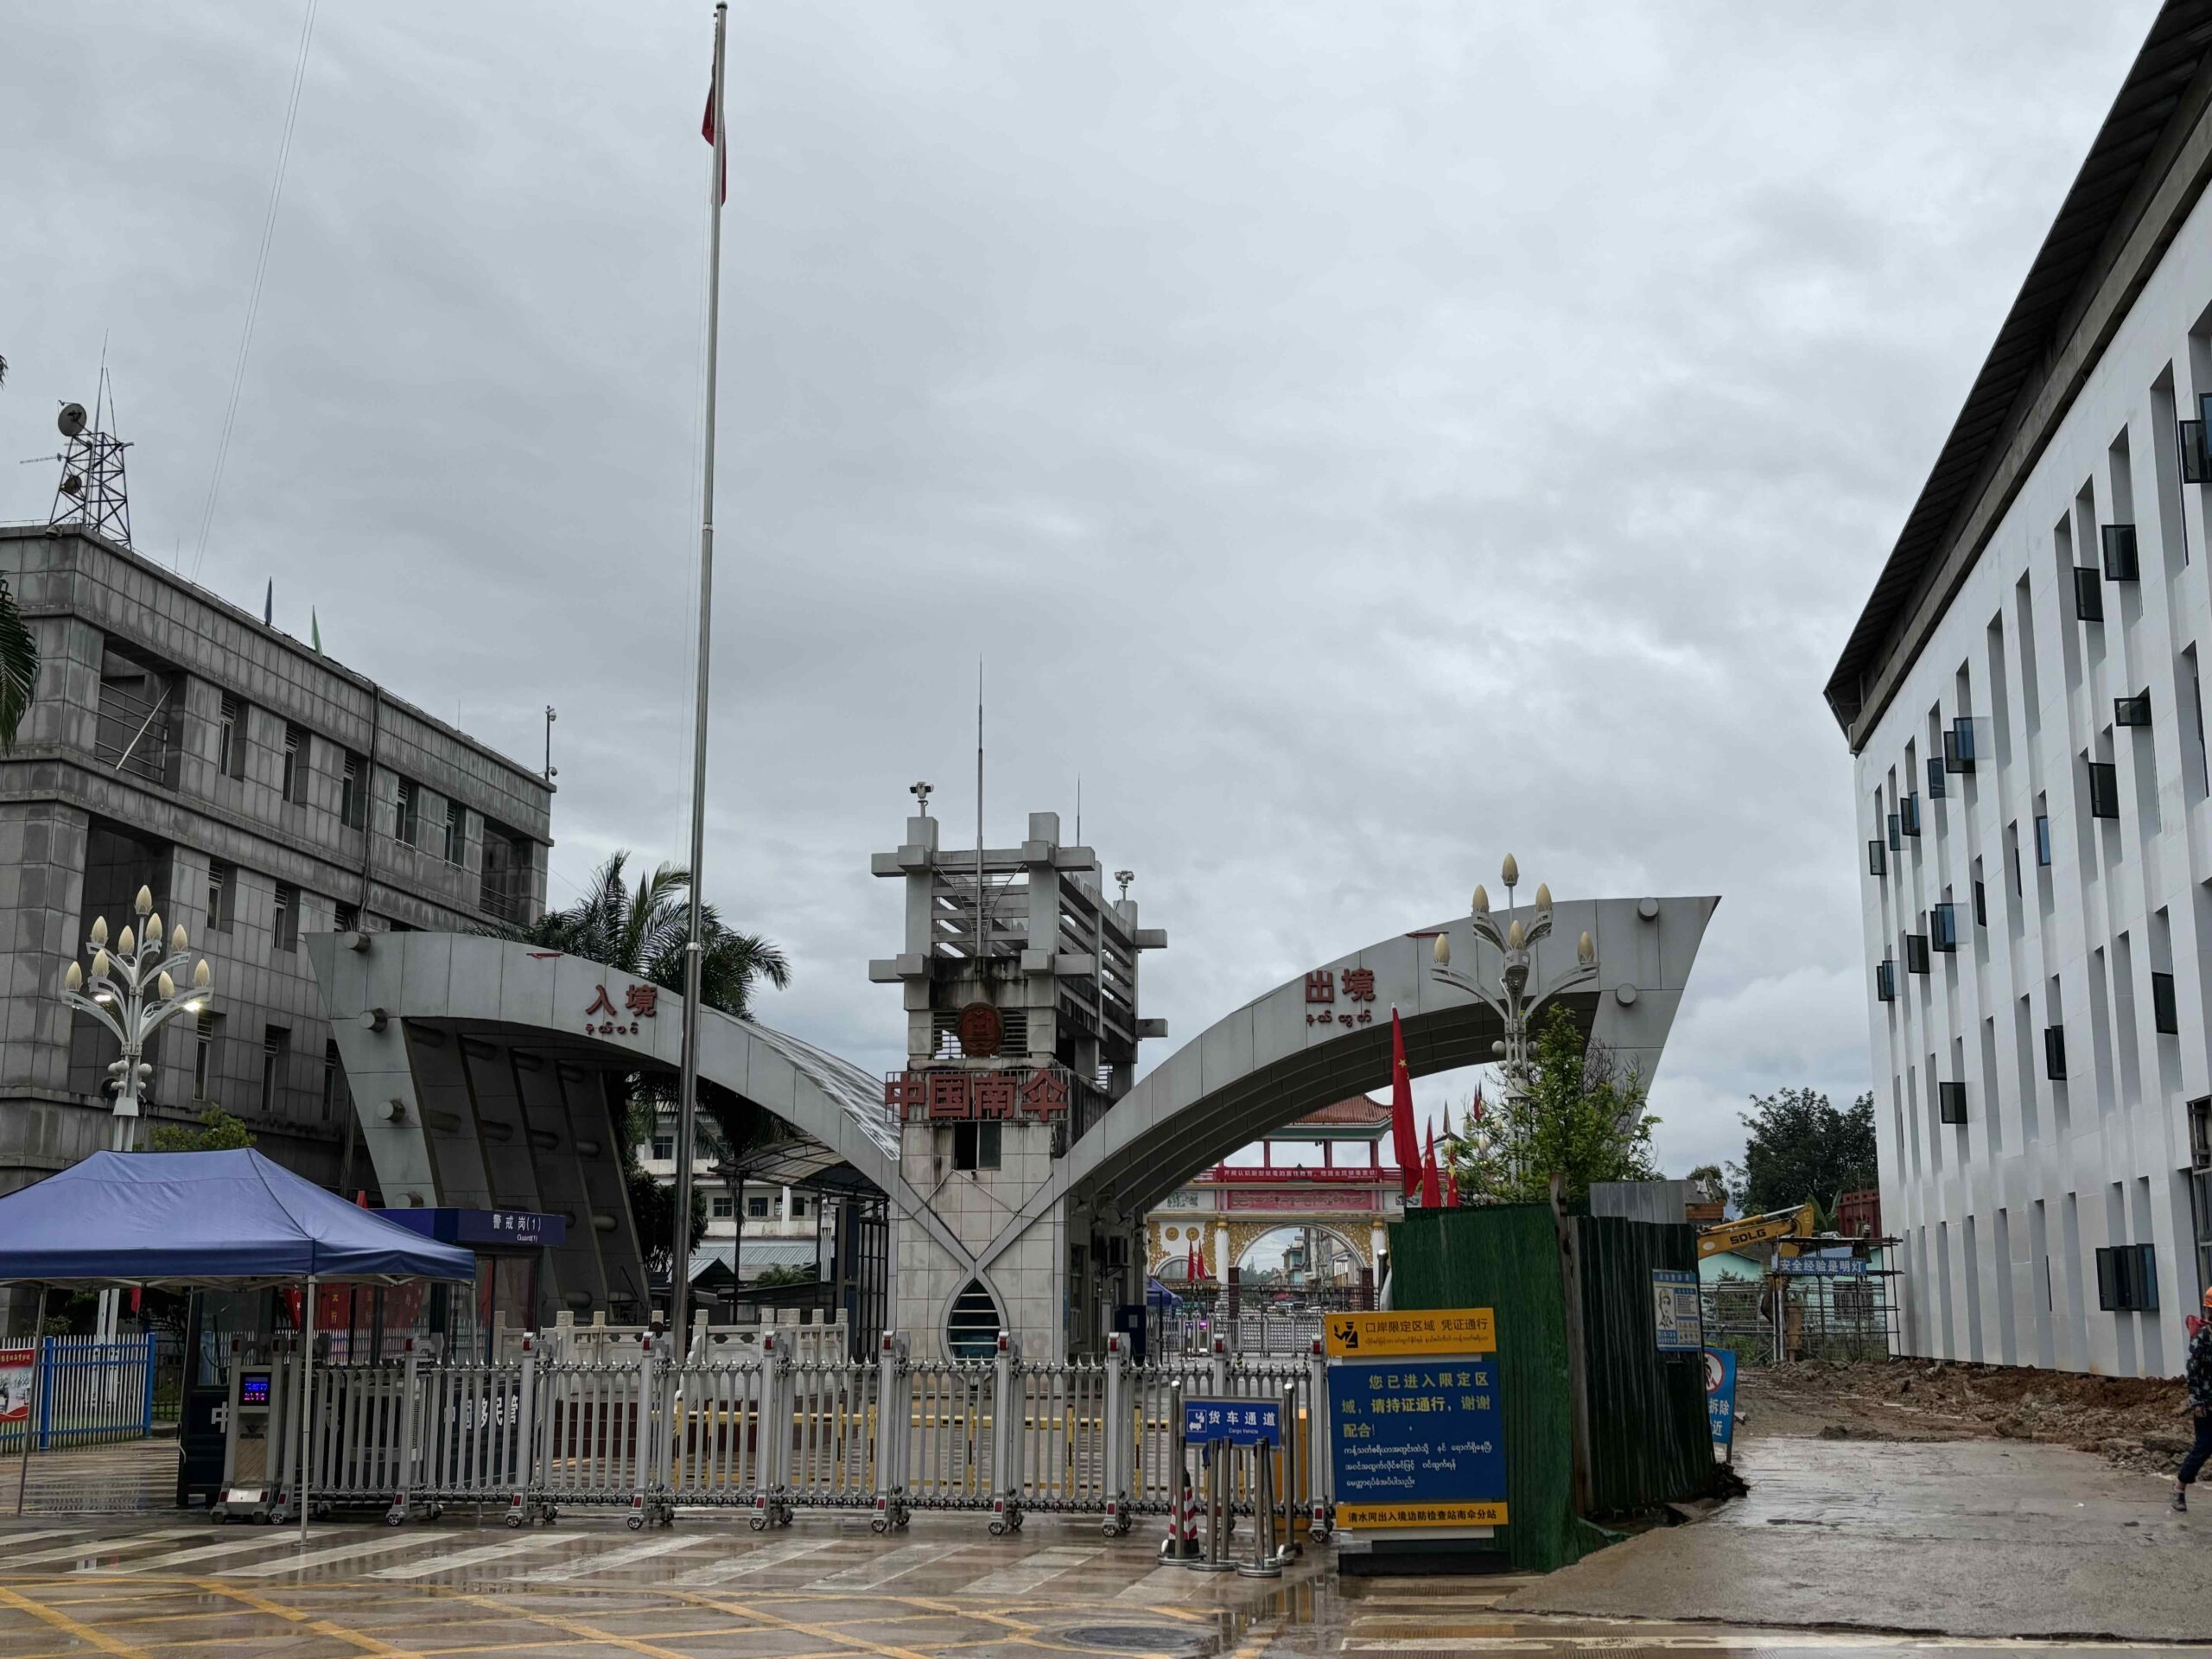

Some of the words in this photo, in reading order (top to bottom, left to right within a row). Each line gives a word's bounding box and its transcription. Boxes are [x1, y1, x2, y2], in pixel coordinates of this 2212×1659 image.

[1306, 968, 1376, 1002] 出境
[586, 984, 657, 1017] 入境
[886, 1068, 1068, 1122] 中国南伞
[1730, 1228, 1767, 1245] SDLG
[1781, 1259, 1862, 1273] 安全经验是明灯
[1365, 1319, 1436, 1332] 口岸限定区域
[1441, 1318, 1489, 1331] 凭证通行
[1369, 1371, 1489, 1389] 您已进入限定区
[1208, 1410, 1275, 1426] 货车通道
